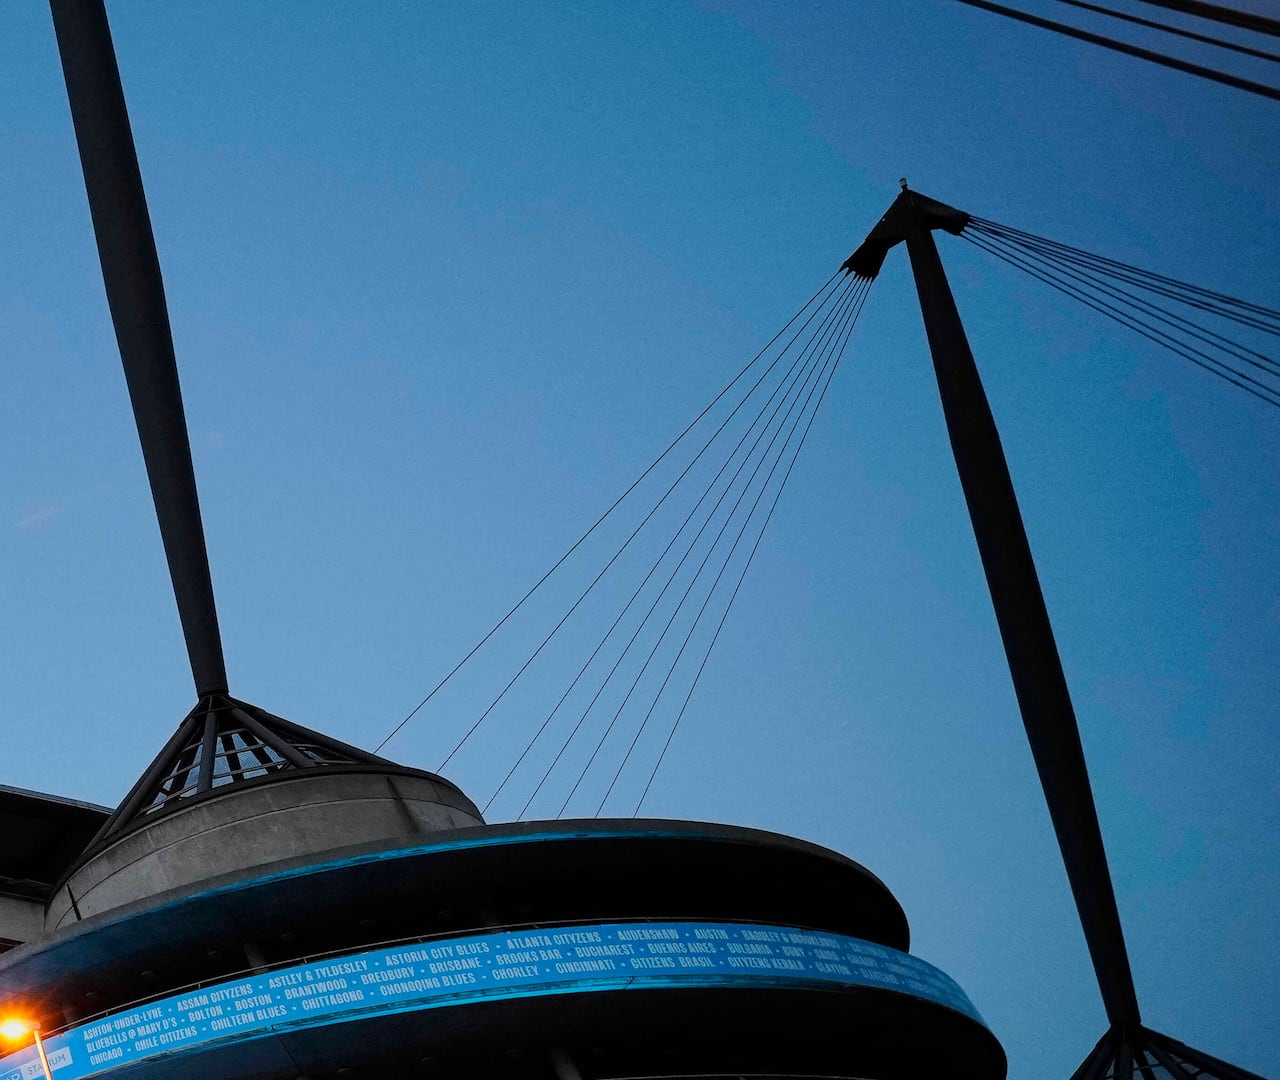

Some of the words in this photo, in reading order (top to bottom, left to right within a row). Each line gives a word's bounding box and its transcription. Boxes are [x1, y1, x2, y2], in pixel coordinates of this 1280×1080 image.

[87, 1033, 128, 1054] BLUEBELLS
[138, 1022, 162, 1038] MARY
[189, 1006, 223, 1023] BOLTON
[235, 994, 272, 1011] BOSTON
[285, 980, 347, 1000] BRANTWOOD
[362, 968, 415, 985] BREDBURY
[429, 958, 482, 974] BRISBANE
[496, 950, 540, 966] BROOKS
[541, 949, 562, 962] BAR
[135, 1036, 158, 1052] CHILE
[256, 1004, 286, 1020] BLUES
[441, 972, 476, 988] BLUES
[177, 994, 209, 1012] ASSAM
[268, 972, 304, 990] ASTLEY
[385, 951, 430, 967] ASTORIA
[430, 946, 454, 961] CITY
[458, 942, 490, 956] BLUES
[507, 934, 552, 950] ATLANTA
